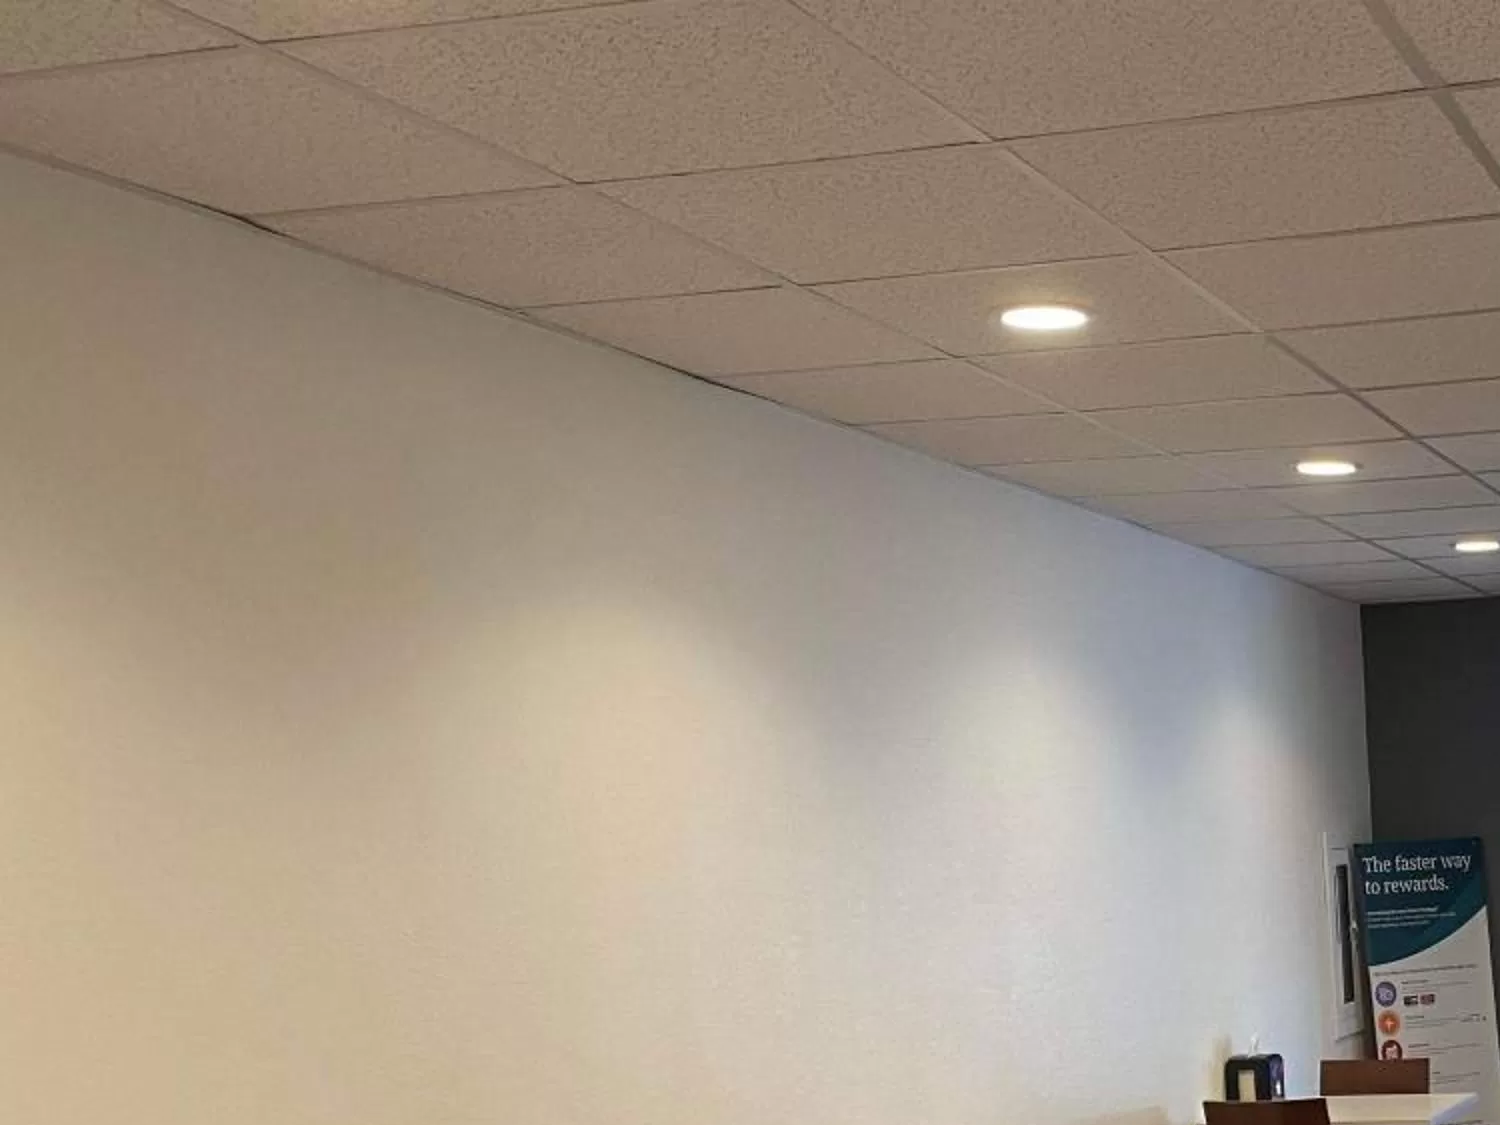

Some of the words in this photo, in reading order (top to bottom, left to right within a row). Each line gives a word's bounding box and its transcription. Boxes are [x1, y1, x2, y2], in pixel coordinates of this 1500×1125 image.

[1362, 856, 1391, 873] The
[1395, 855, 1437, 871] faster
[1440, 855, 1472, 873] way
[1365, 880, 1381, 895] to
[1383, 874, 1449, 894] rewards.
